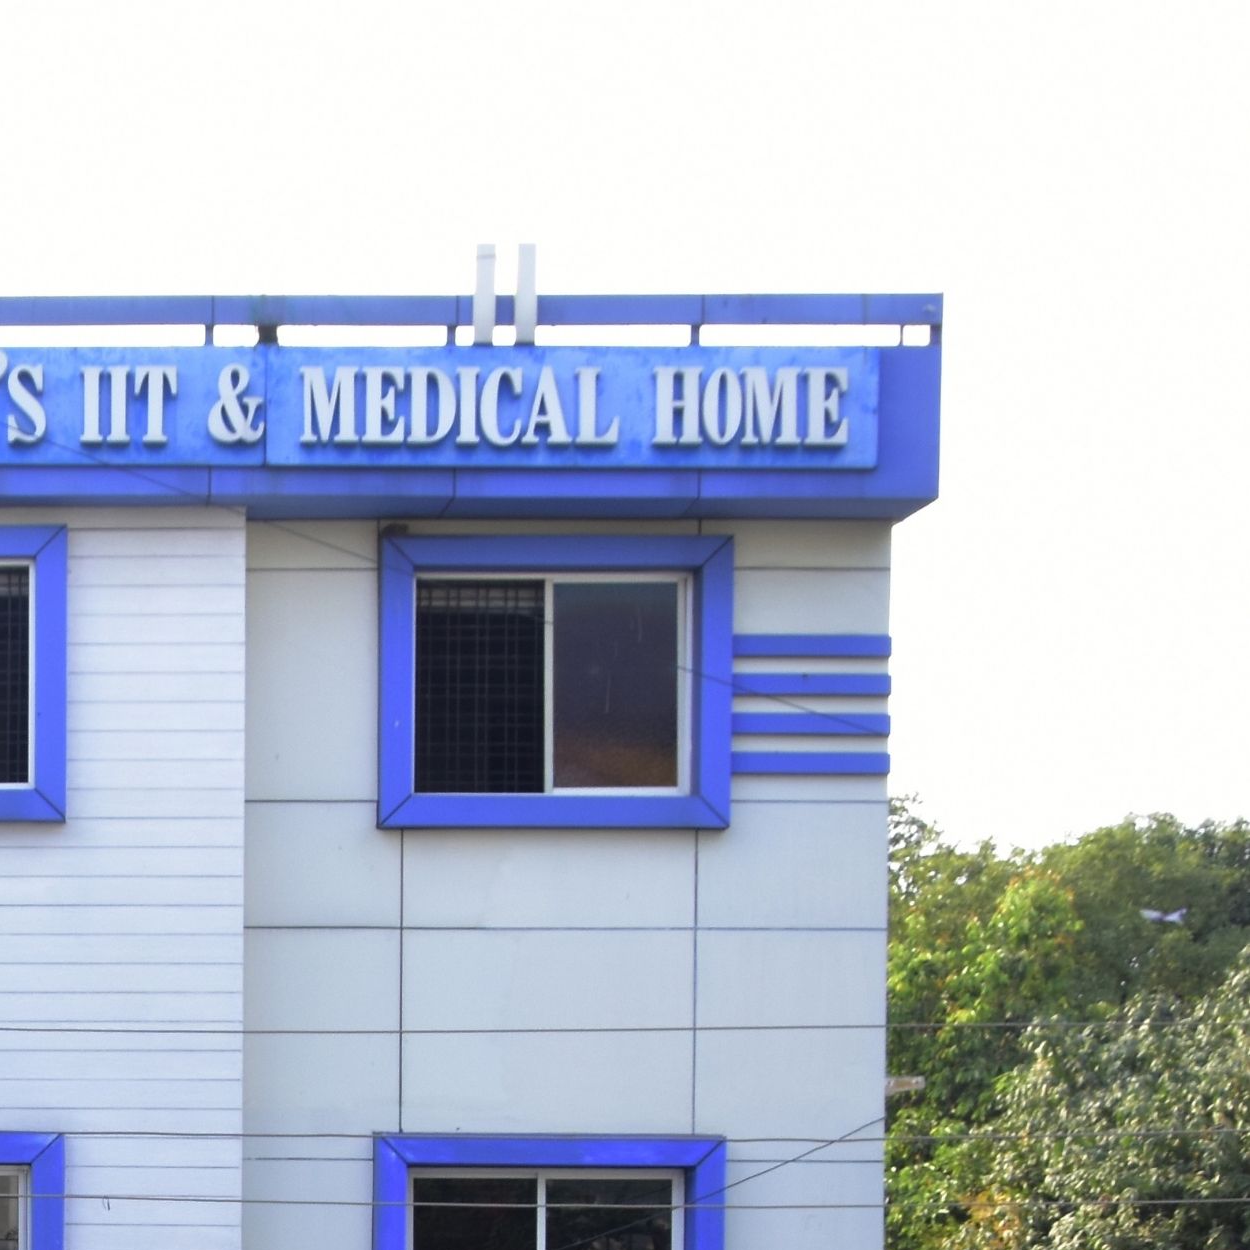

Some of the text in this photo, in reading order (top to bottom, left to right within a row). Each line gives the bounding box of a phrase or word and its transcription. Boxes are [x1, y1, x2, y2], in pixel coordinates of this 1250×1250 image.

[79, 365, 178, 445] IIT
[207, 363, 264, 445] &
[299, 365, 621, 446] MEDICAL
[652, 366, 849, 448] HOME
